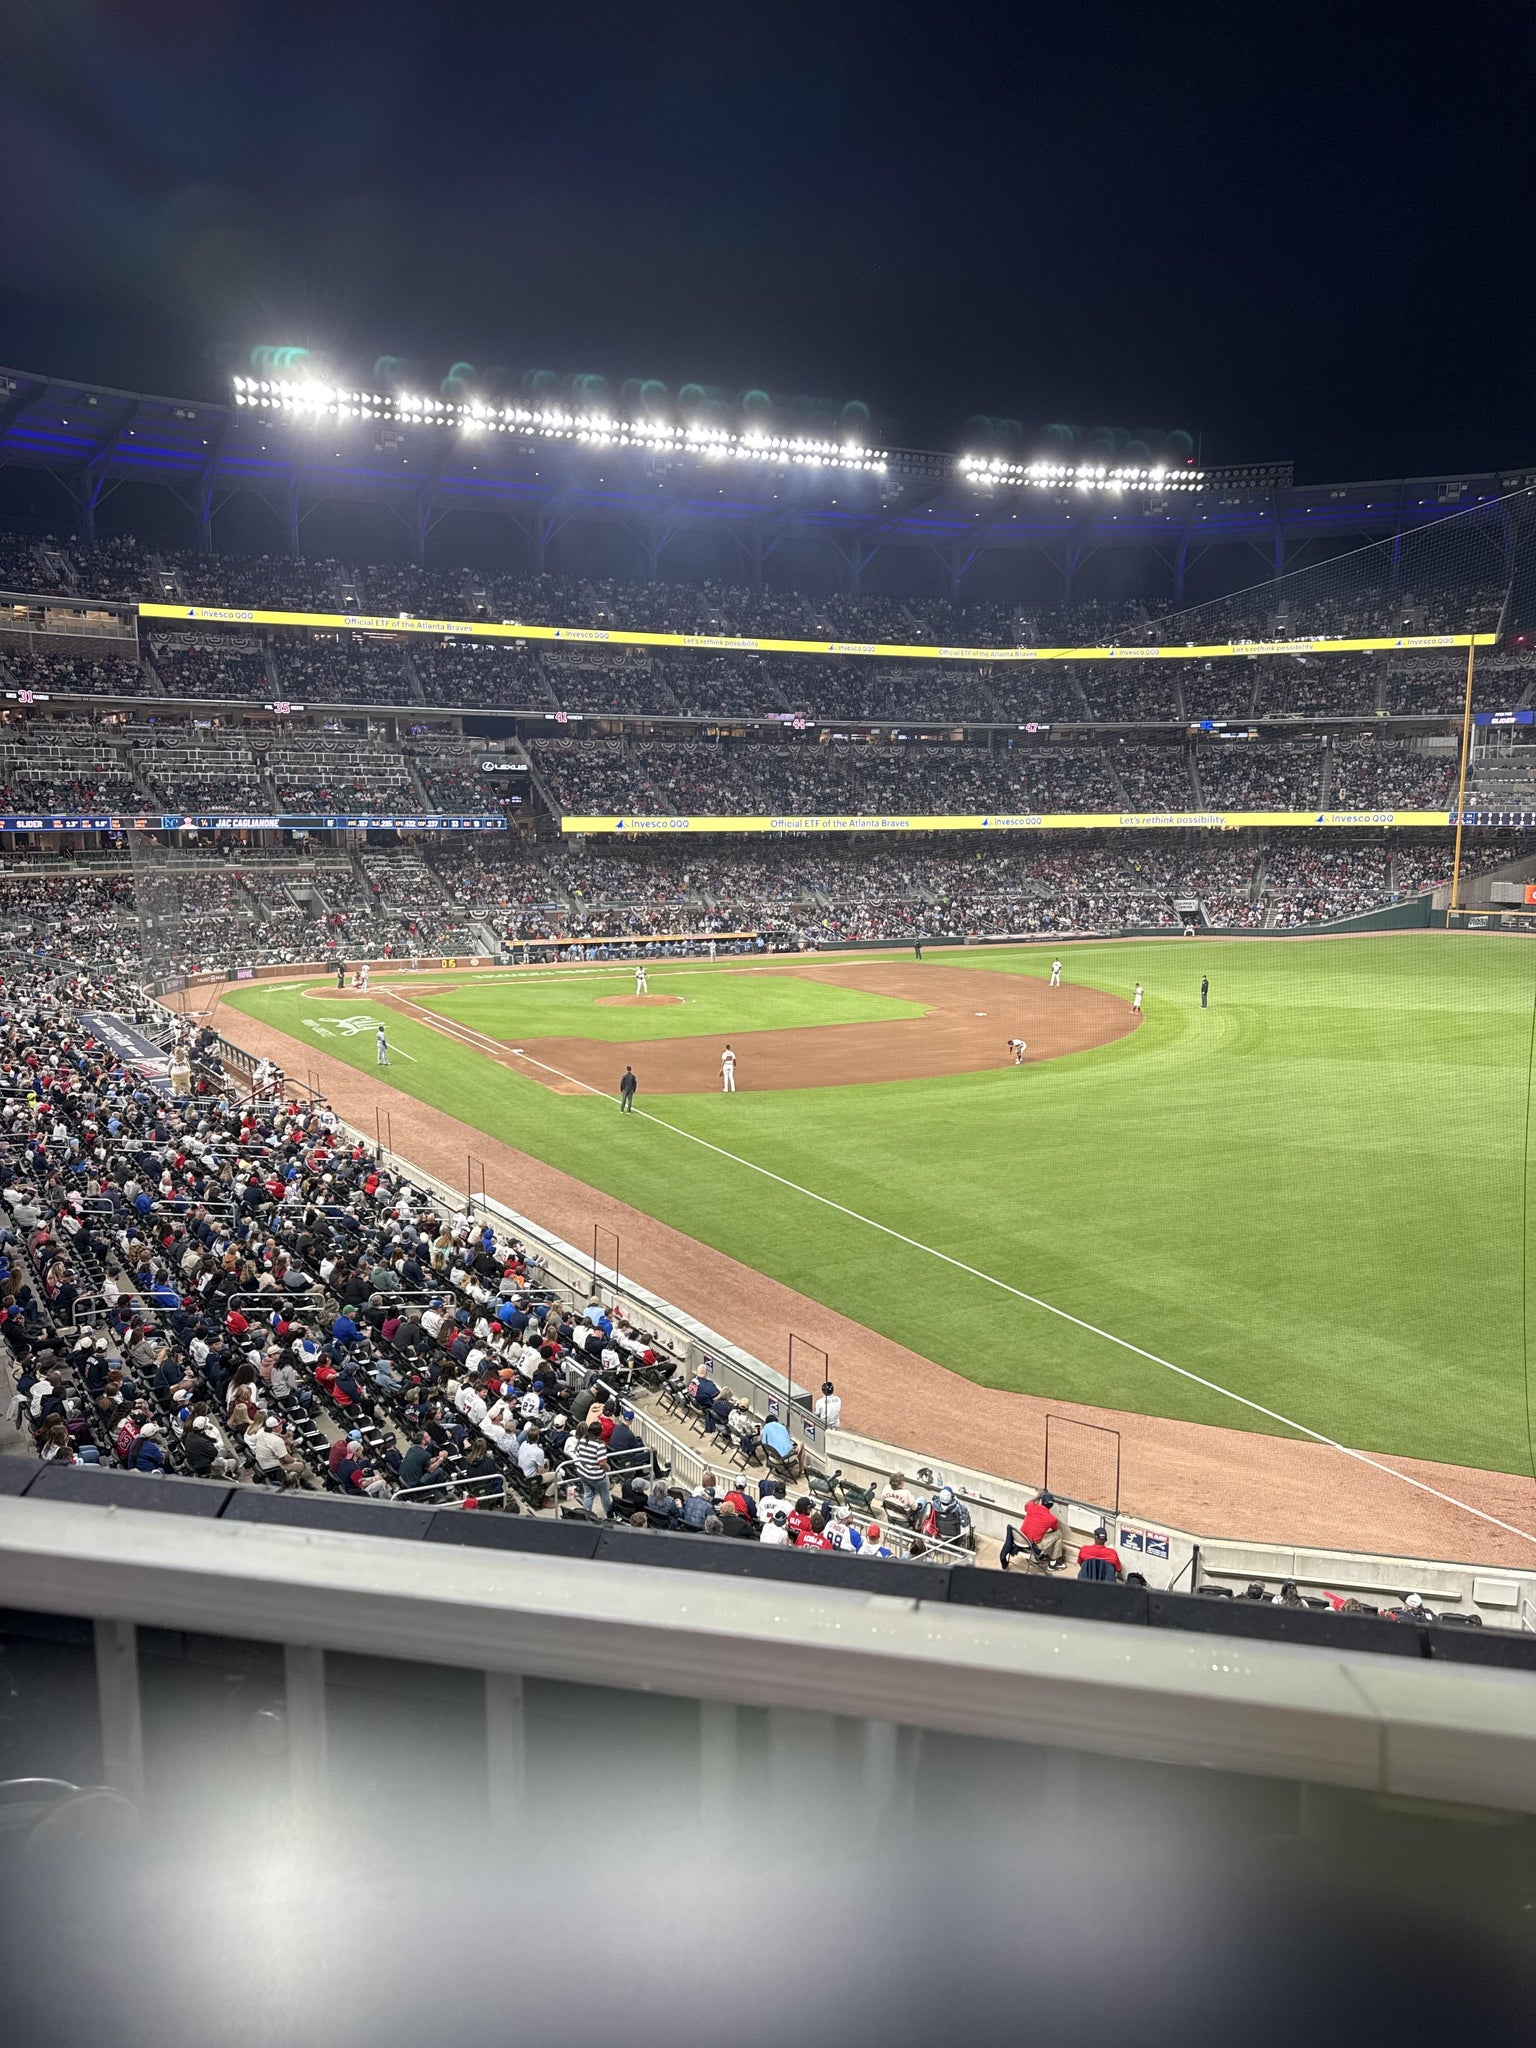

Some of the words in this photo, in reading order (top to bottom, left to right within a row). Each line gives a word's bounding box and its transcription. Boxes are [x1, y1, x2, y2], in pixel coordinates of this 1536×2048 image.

[201, 610, 234, 618] Invesco
[344, 618, 374, 626] Official
[401, 621, 415, 629] the
[416, 622, 445, 630] Atlanta
[446, 624, 473, 632] Braves
[683, 637, 699, 645] Let's
[700, 638, 723, 646] rethink
[18, 690, 33, 703] 31
[274, 702, 290, 713] 35
[555, 712, 568, 723] 41
[494, 763, 528, 771] LEXUS
[216, 818, 231, 828] JAC
[232, 818, 279, 828] CAGLIANONE
[1025, 817, 1042, 825] QQQ
[1119, 816, 1140, 824] Let's
[1142, 815, 1174, 824] rethink
[1176, 815, 1227, 825] possibility.
[1331, 814, 1371, 823] Invesco
[1372, 814, 1394, 823] QQQ
[16, 820, 43, 828] SLIDER
[631, 819, 668, 828] Invesco
[669, 819, 690, 828] QQQ
[770, 819, 802, 828] Official
[804, 819, 820, 828] ETF
[822, 819, 832, 828] of
[833, 819, 847, 828] the
[848, 819, 879, 827] Atlanta
[881, 819, 909, 827] Braves
[522, 1401, 535, 1413] 27
[826, 1531, 843, 1550] 99
